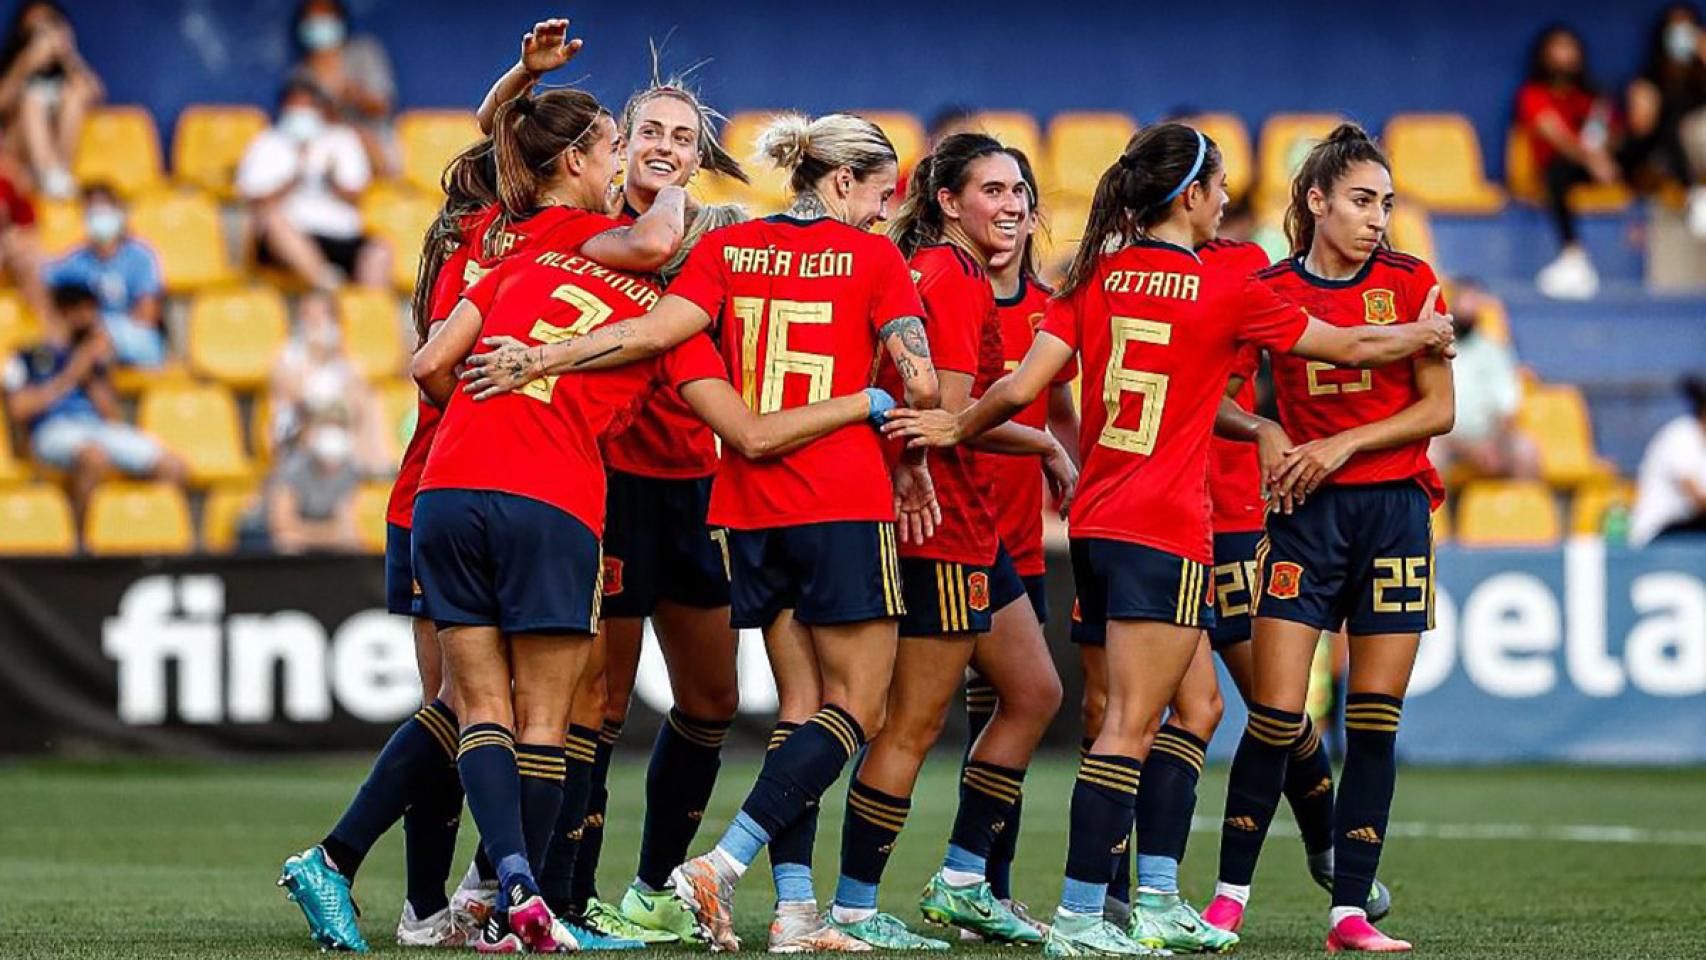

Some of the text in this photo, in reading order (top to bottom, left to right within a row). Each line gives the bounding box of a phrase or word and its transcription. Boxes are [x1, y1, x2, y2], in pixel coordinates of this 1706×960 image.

[800, 249, 853, 277] LEÓN
[1105, 271, 1200, 300] AITANA
[733, 297, 834, 415] 16
[1099, 316, 1171, 455] 6
[1373, 557, 1427, 612] 25
